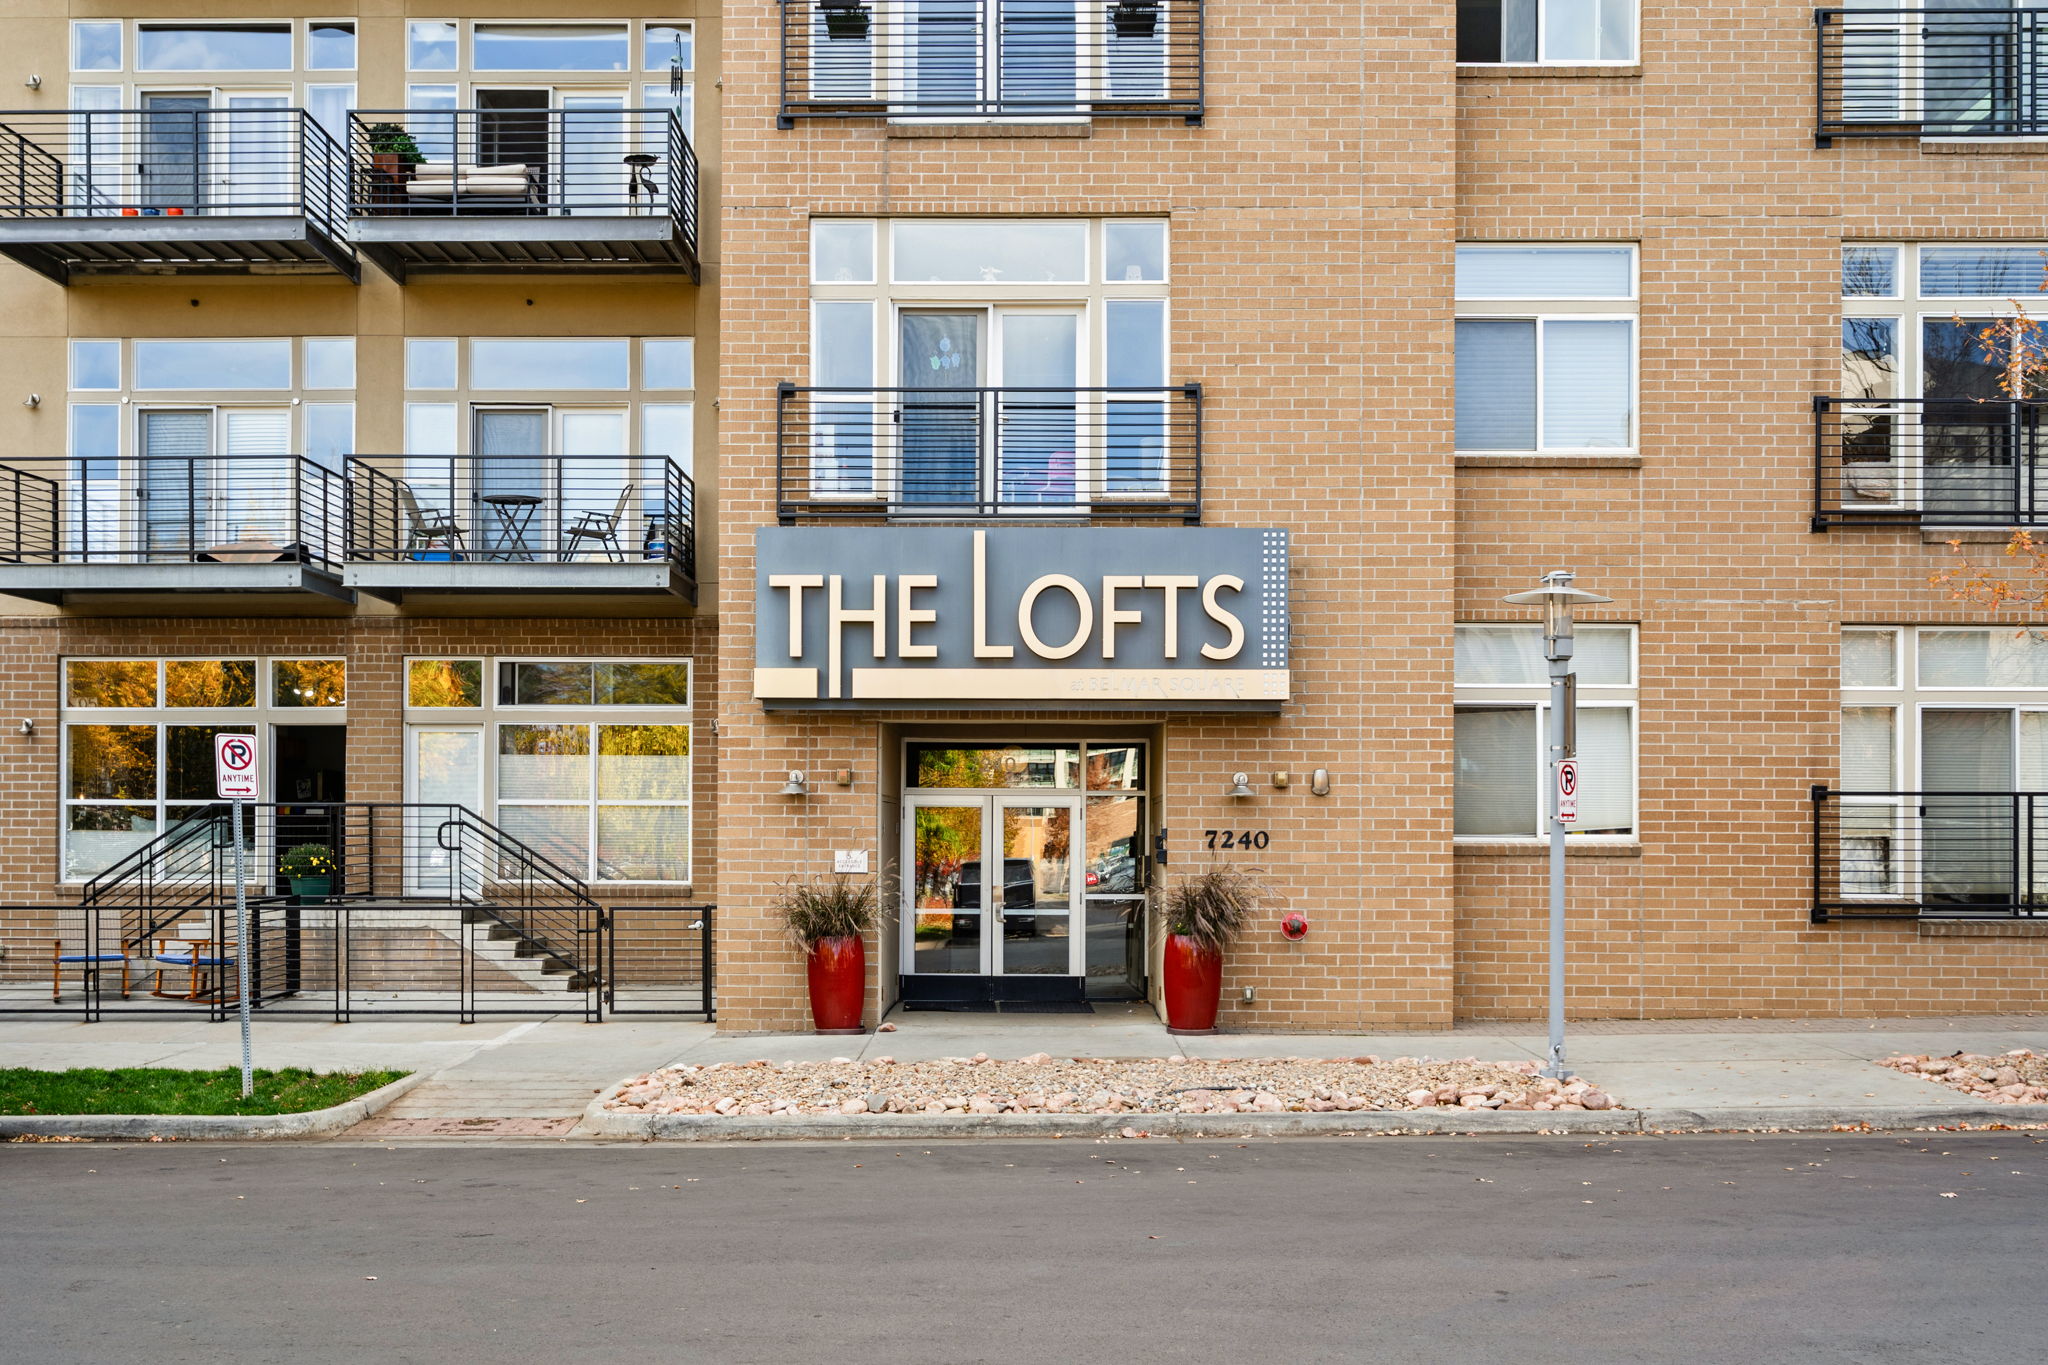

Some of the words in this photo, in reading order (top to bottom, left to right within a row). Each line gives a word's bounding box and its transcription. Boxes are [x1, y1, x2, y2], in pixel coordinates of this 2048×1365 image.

[769, 574, 938, 698] THE
[973, 529, 1246, 661] LOFTS
[1071, 679, 1085, 692] at
[1089, 671, 1168, 698] BELMAR
[1168, 671, 1246, 699] SQUARE
[222, 774, 255, 783] ANYTIME
[1204, 829, 1270, 851] 7240
